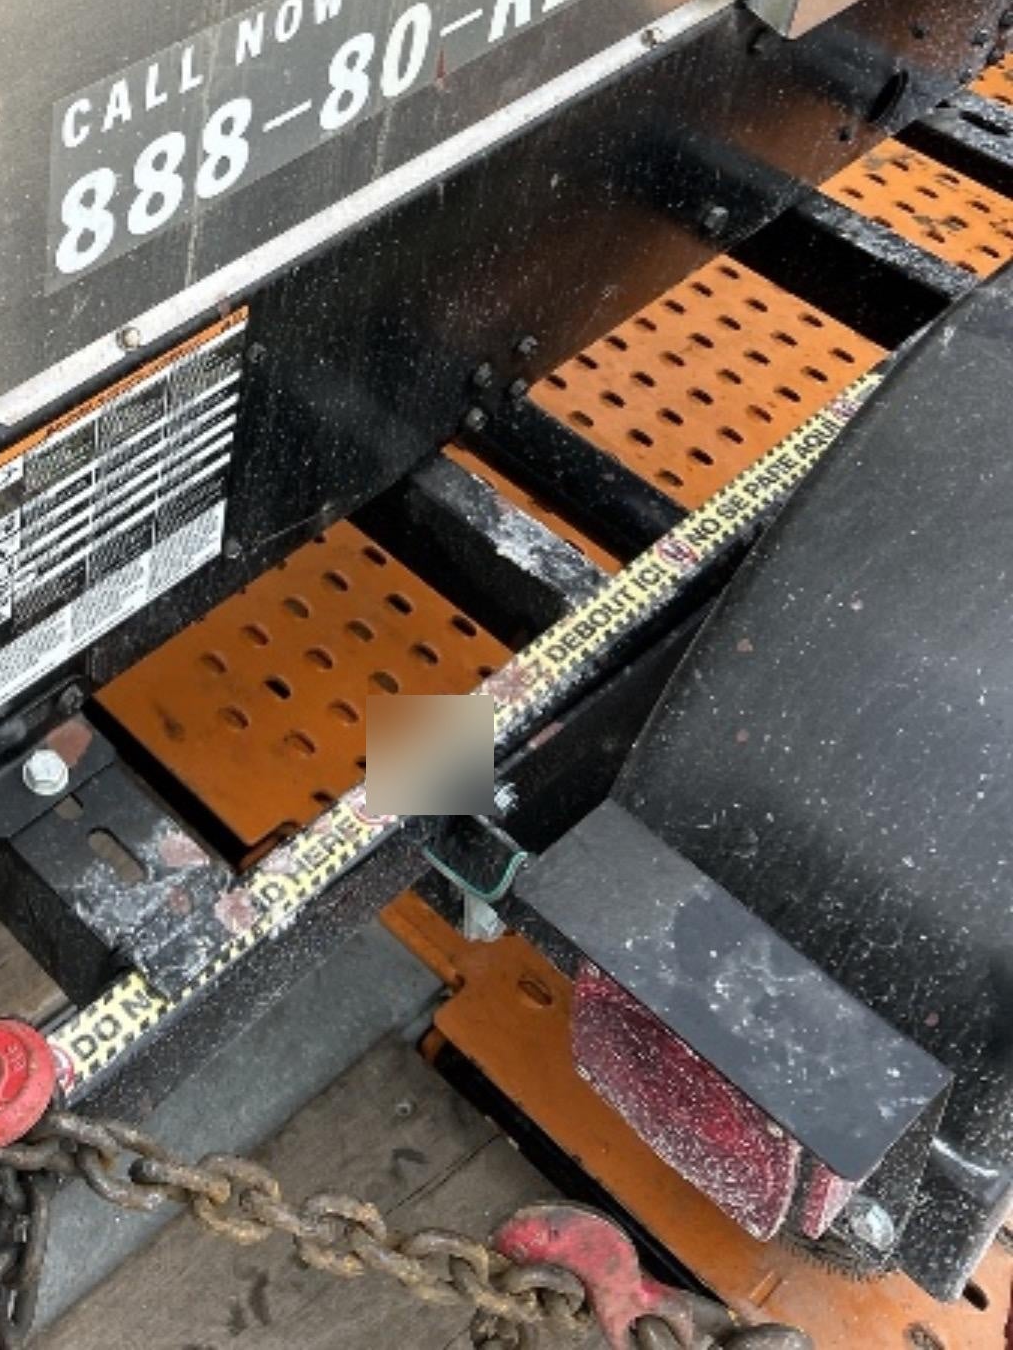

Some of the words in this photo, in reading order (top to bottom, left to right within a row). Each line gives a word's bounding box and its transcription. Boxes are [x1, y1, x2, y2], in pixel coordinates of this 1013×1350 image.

[61, 49, 206, 150] CALL
[686, 516, 721, 547] NO
[716, 494, 750, 520] SE
[542, 585, 637, 663] DEBOUT
[635, 561, 667, 593] ICI
[70, 1012, 123, 1061] DO
